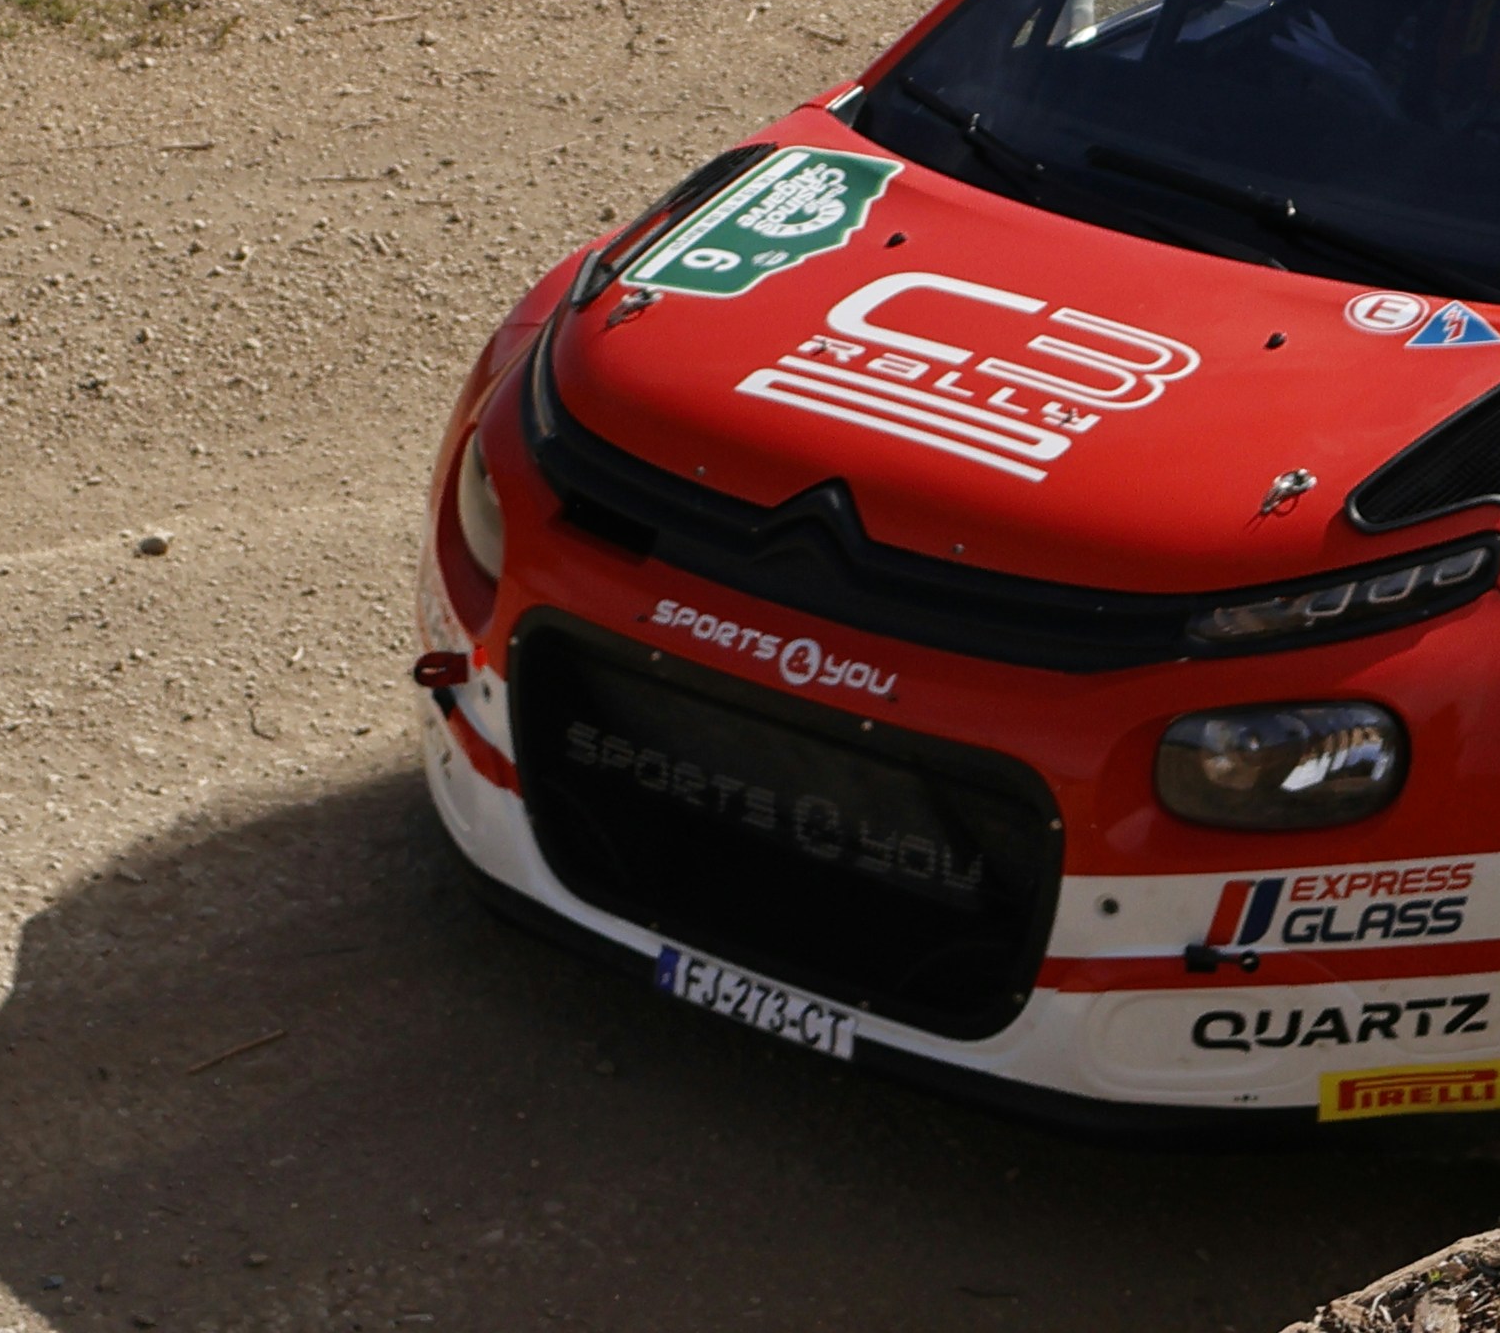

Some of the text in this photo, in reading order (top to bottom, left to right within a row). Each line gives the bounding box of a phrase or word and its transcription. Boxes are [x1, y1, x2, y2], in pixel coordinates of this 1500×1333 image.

[736, 167, 822, 228] Algarve
[753, 167, 846, 232] Casinos
[681, 247, 742, 272] 6
[826, 271, 1201, 411] C3
[1363, 297, 1410, 325] E
[651, 598, 782, 661] SPORTS
[818, 654, 898, 696] YOU
[566, 721, 777, 829] SPORTS
[856, 819, 984, 890] YOU
[1288, 862, 1476, 902] EXPRESS
[1282, 896, 1469, 945] GLASS
[684, 958, 848, 1054] FJ-273-CT
[1191, 992, 1491, 1053] QUARTZ
[1337, 1068, 1499, 1112] PIRELLI
